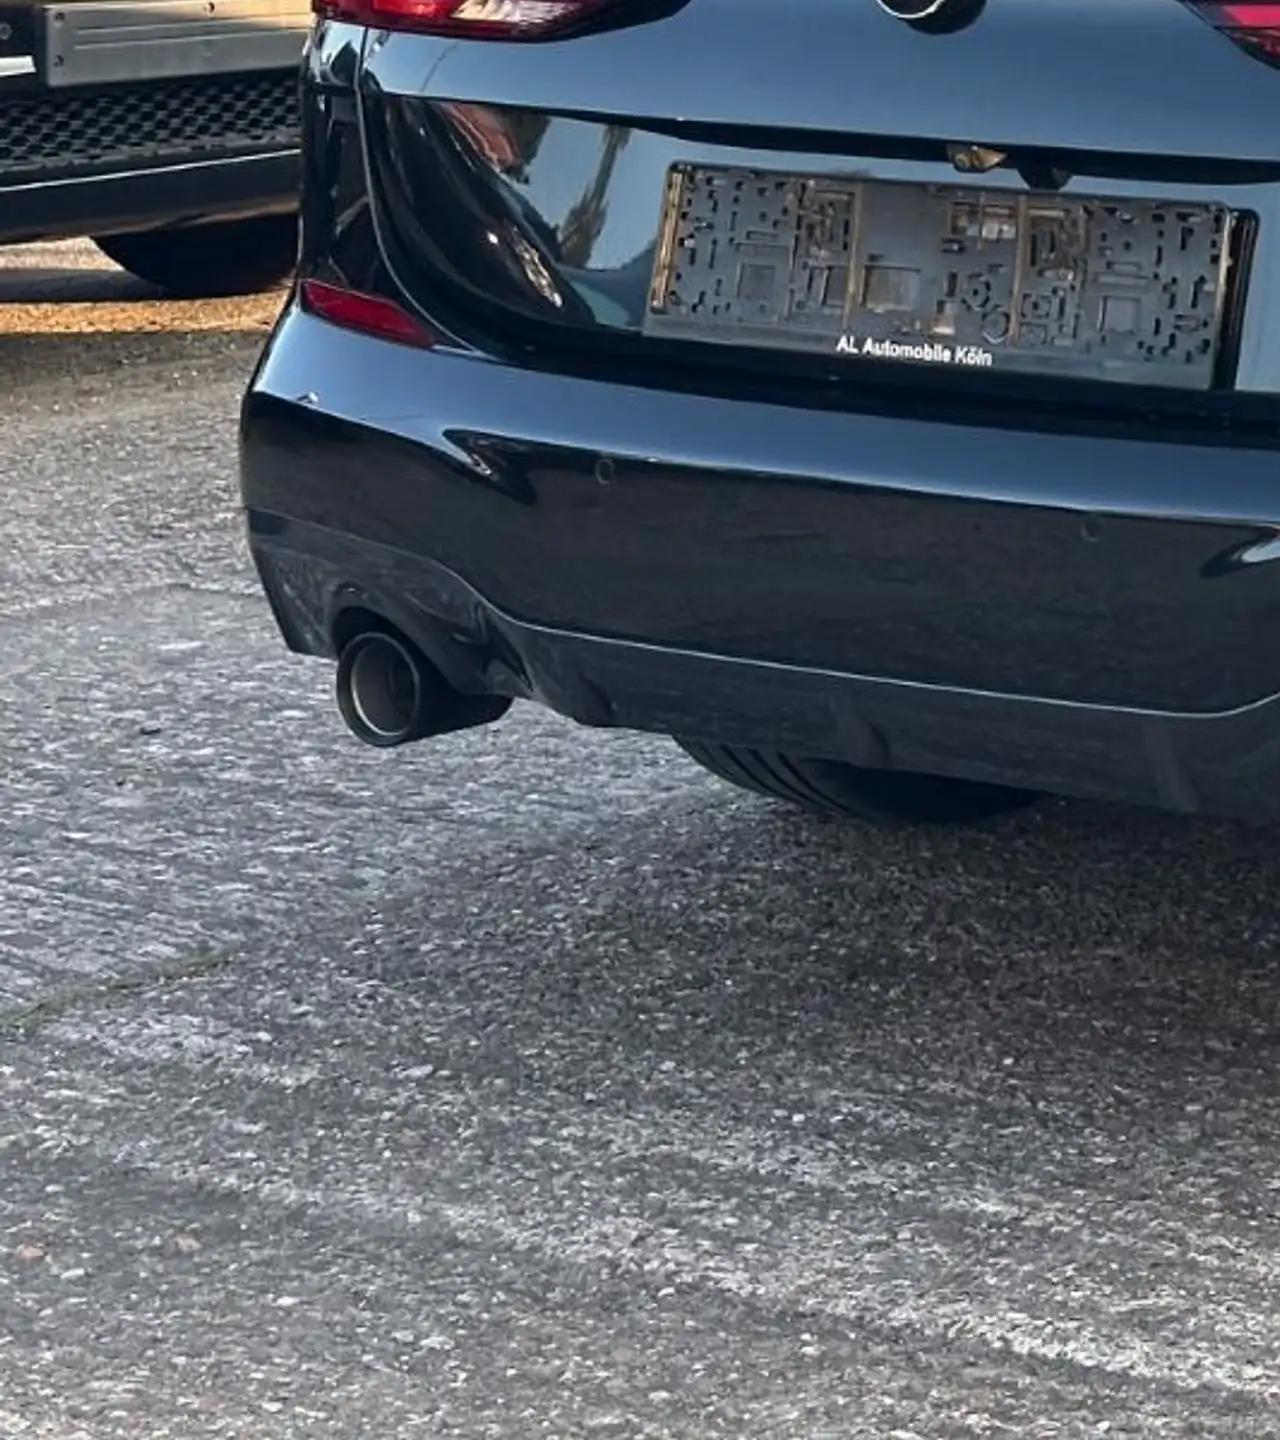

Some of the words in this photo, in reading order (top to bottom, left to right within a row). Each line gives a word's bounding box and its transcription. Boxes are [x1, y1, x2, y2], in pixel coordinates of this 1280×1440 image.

[836, 335, 858, 354] AL
[862, 337, 951, 362] Automobile
[955, 346, 992, 366] Köln
